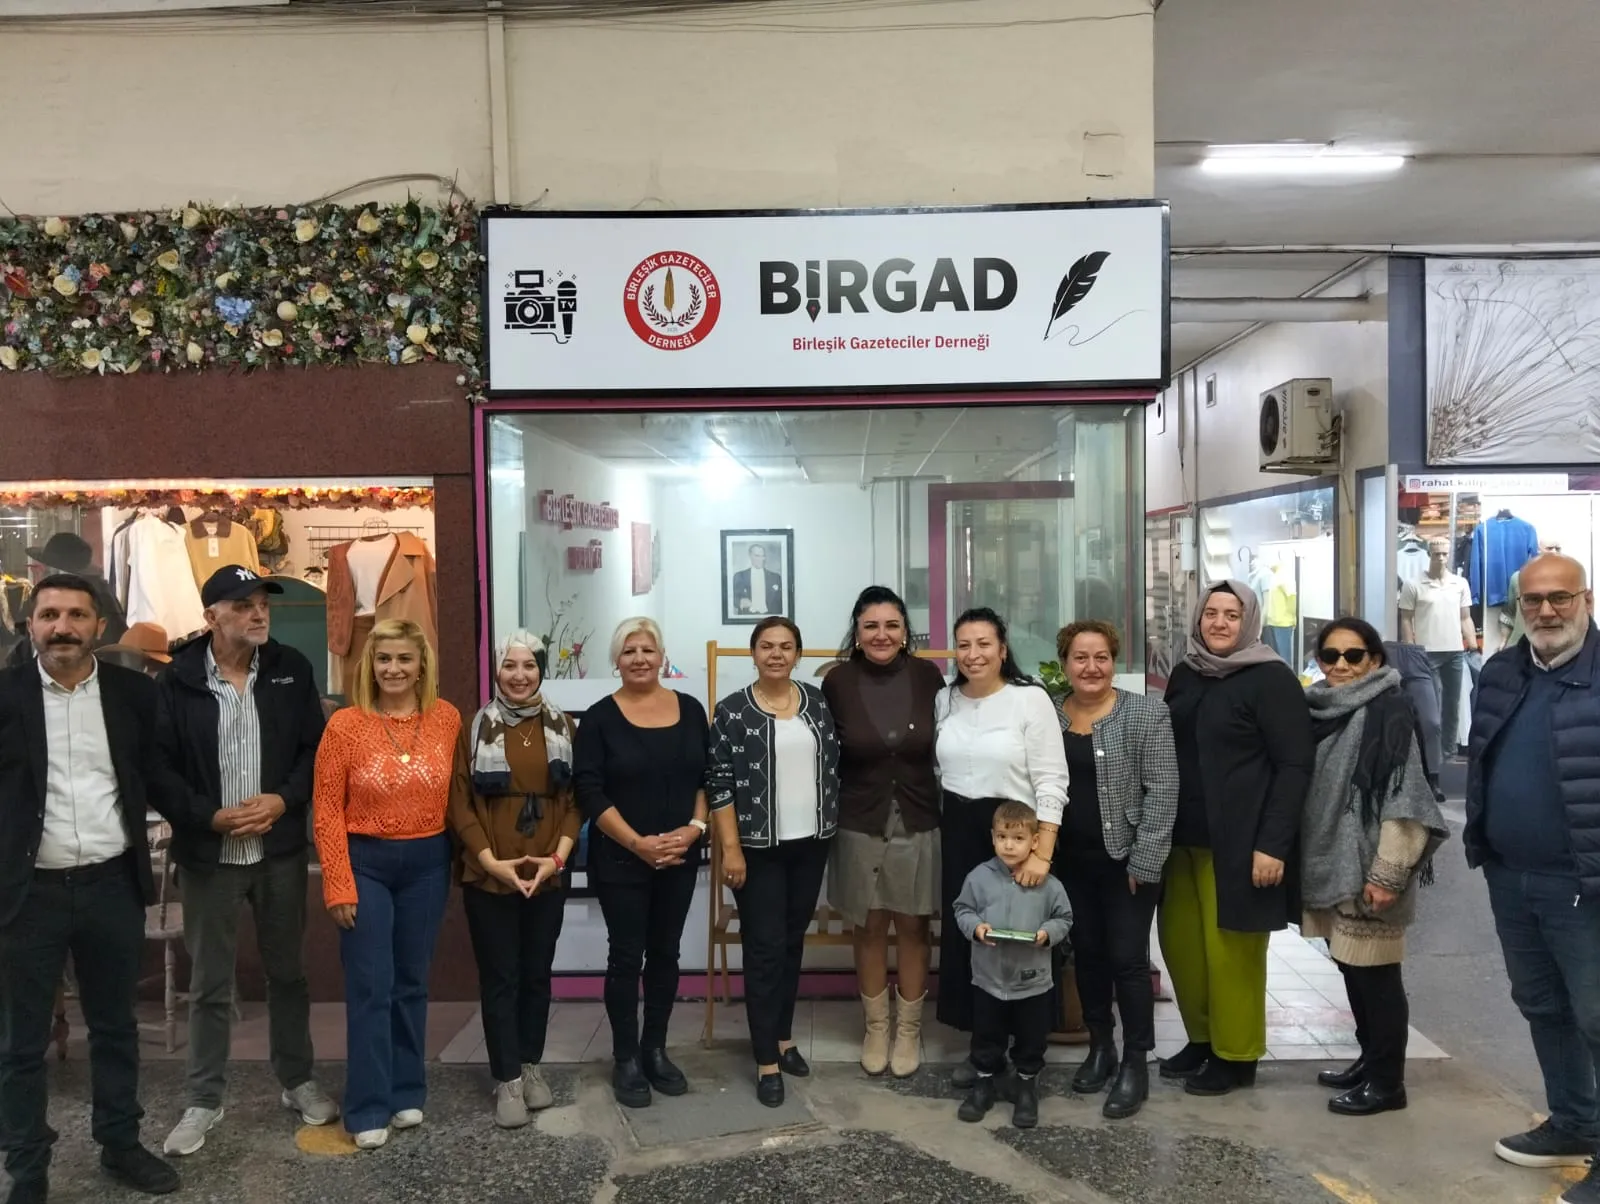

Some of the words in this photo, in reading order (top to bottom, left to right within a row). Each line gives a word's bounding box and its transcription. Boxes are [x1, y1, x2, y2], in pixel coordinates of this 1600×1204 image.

[627, 257, 659, 301] BİRLEŞİK
[659, 254, 717, 299] GAZETECİLER
[648, 332, 697, 349] DERNEĞİ
[792, 336, 846, 353] Birleşik
[850, 335, 931, 350] Gazeteciler
[935, 333, 990, 351] Derneği
